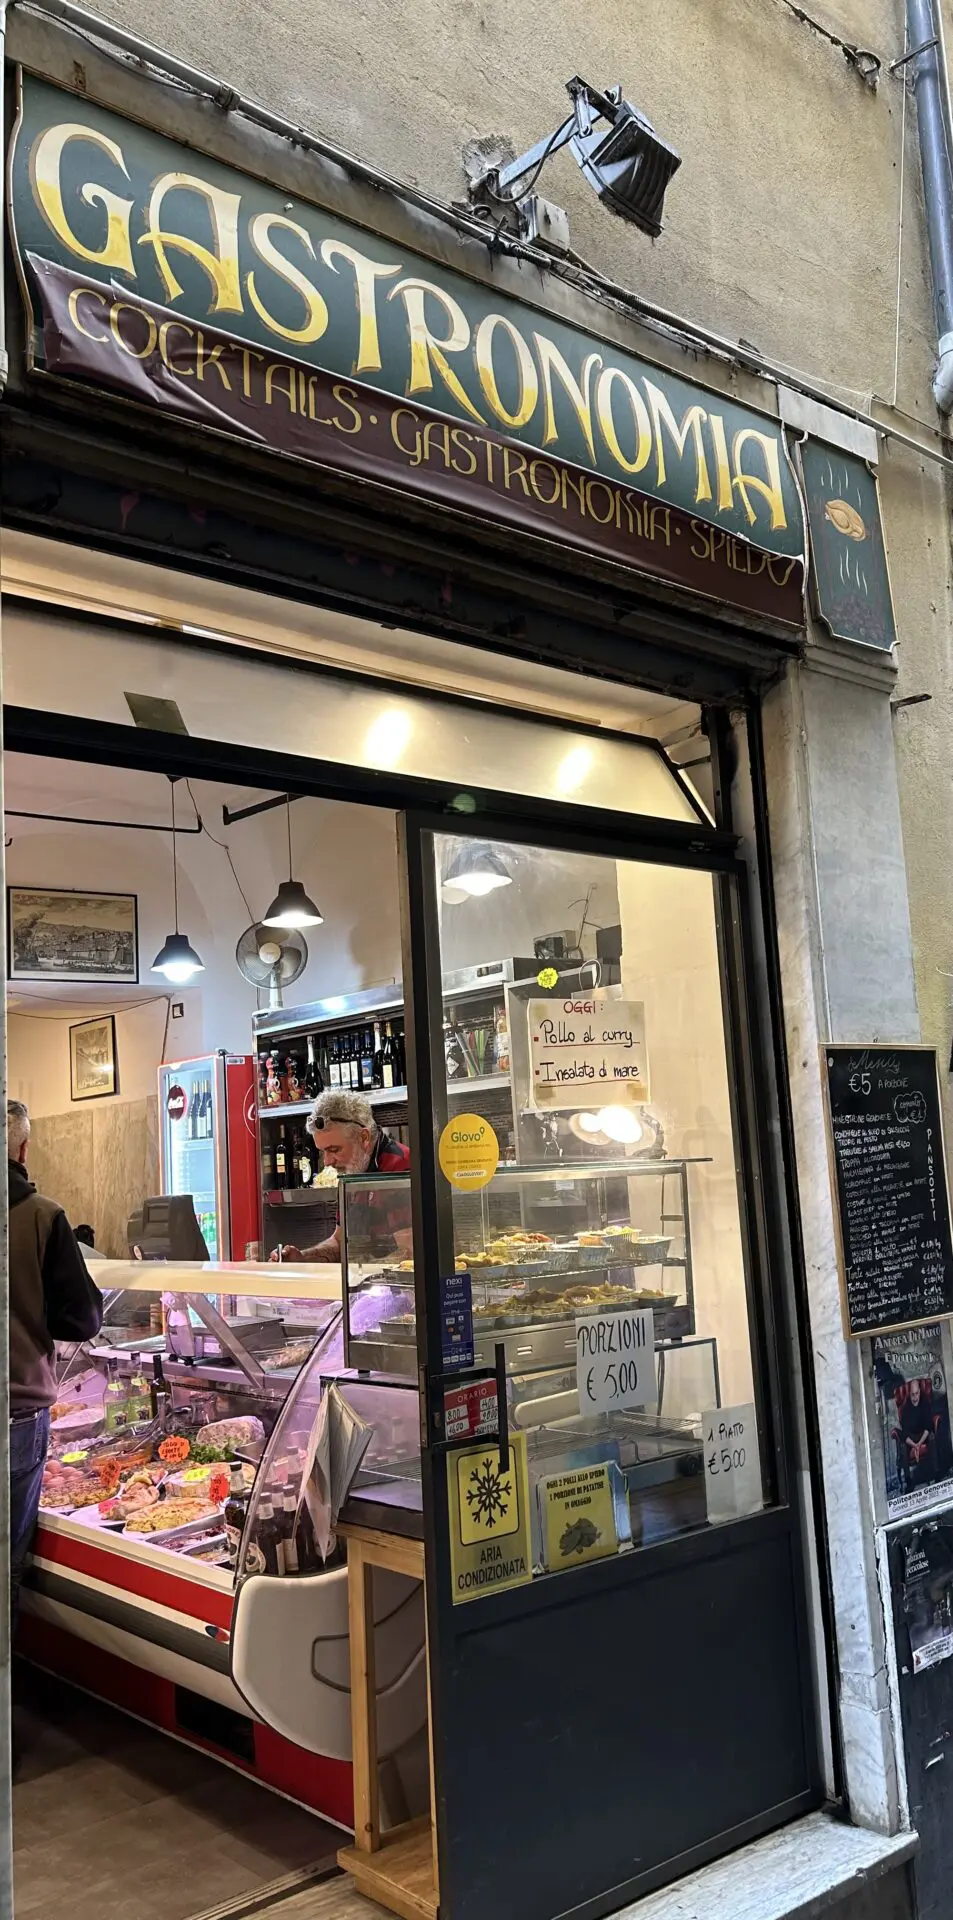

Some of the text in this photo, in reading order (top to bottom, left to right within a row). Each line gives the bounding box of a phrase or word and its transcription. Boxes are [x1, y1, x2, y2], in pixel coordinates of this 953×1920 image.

[28, 122, 787, 531] GASTRONOMIA
[67, 288, 362, 433] COCKTAILS
[391, 408, 671, 546] GASTRONOMIA
[540, 1019, 633, 1048] Pollo al curry
[540, 1061, 596, 1082] Insalata
[613, 1066, 640, 1078] mare
[451, 1130, 482, 1143] Glovo
[446, 1277, 463, 1287] nexi
[577, 1316, 646, 1357] PORZIONI
[586, 1366, 597, 1401] €
[457, 1387, 488, 1403] ORARIO
[718, 1422, 744, 1440] PIATTO
[707, 1451, 720, 1475] €
[563, 1475, 577, 1486] POLLI
[577, 1472, 589, 1482] ALLO
[588, 1469, 605, 1479] SPIEDO
[553, 1488, 576, 1500] PORZIONE
[583, 1481, 605, 1494] PATATINE
[888, 1491, 923, 1508] Politeama
[570, 1495, 592, 1508] OMAGGIO
[480, 1545, 503, 1564] ARIA
[458, 1558, 526, 1590] CONDIZIONATA
